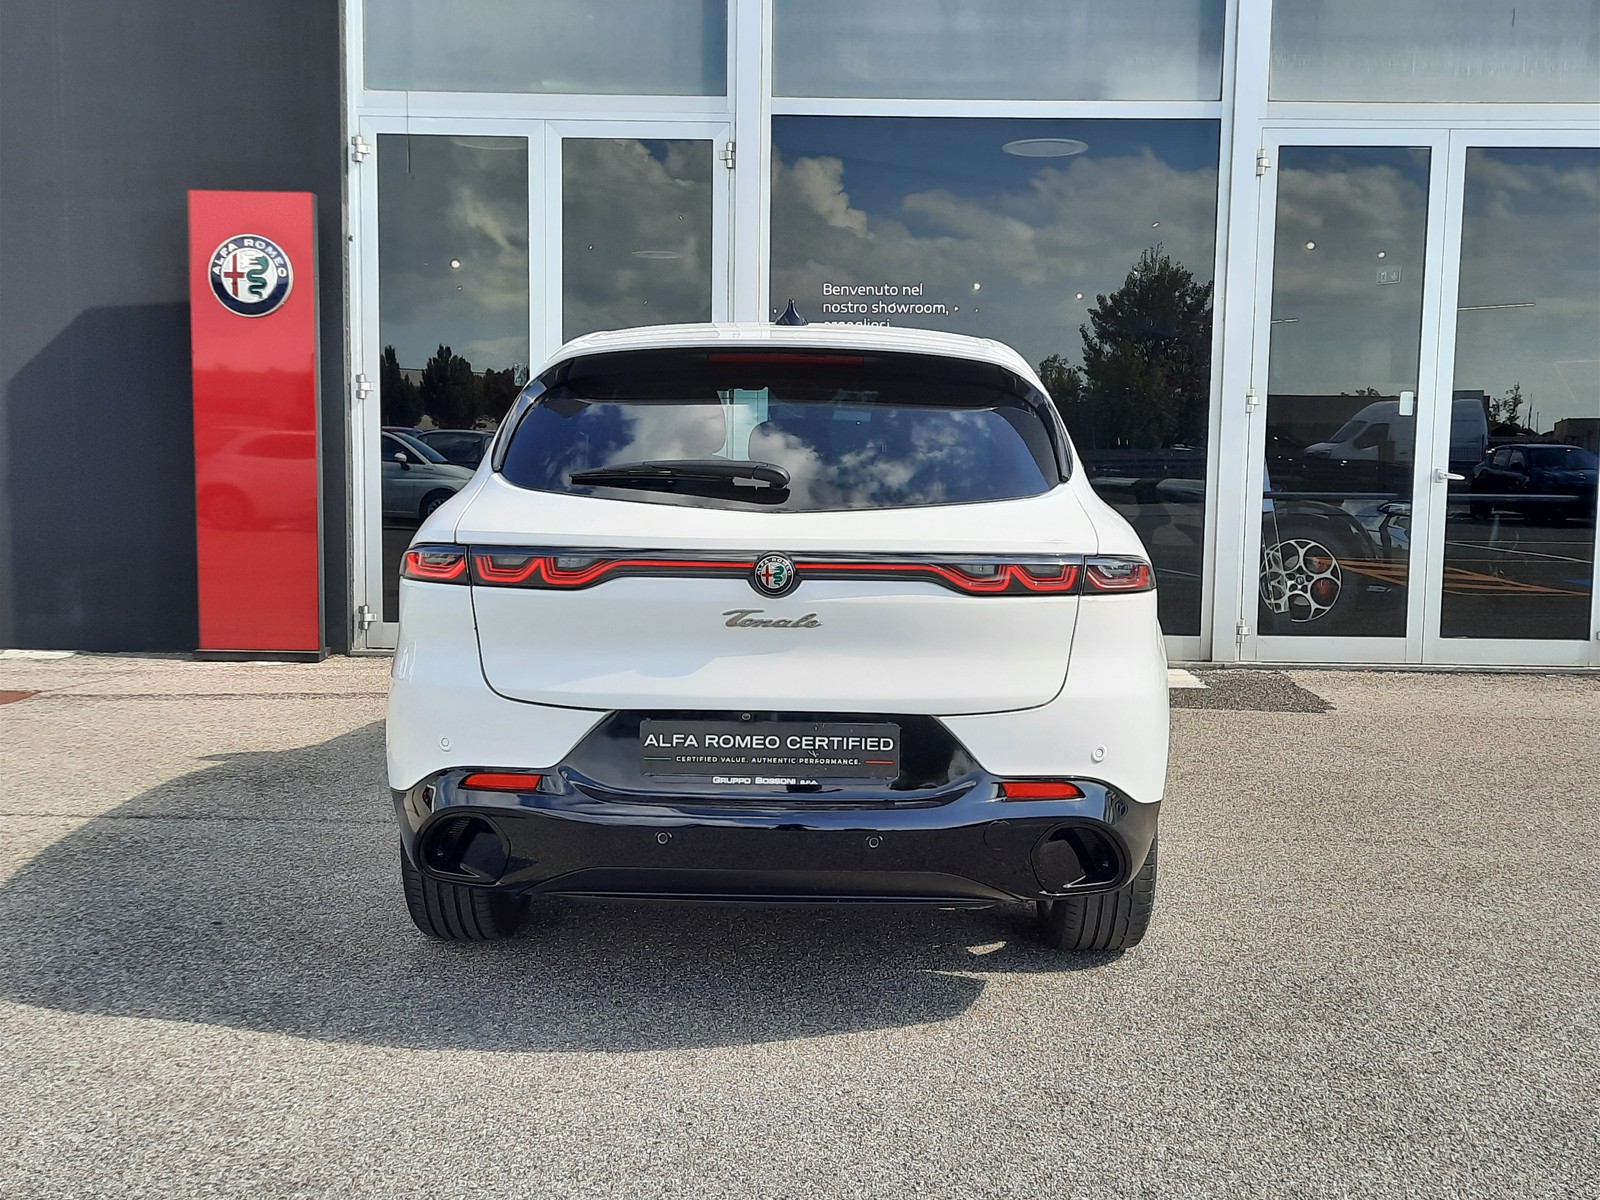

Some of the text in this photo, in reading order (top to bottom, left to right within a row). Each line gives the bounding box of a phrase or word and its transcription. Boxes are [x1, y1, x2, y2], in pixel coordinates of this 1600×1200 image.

[212, 238, 287, 277] ALFA ROMEO
[822, 282, 924, 296] Benvenuto nel
[822, 300, 949, 316] nostro showroom,
[722, 609, 823, 628] Tonale
[643, 733, 894, 751] ALFA ROMEO CERTIFIED
[799, 758, 861, 766] PERFORMANCE.
